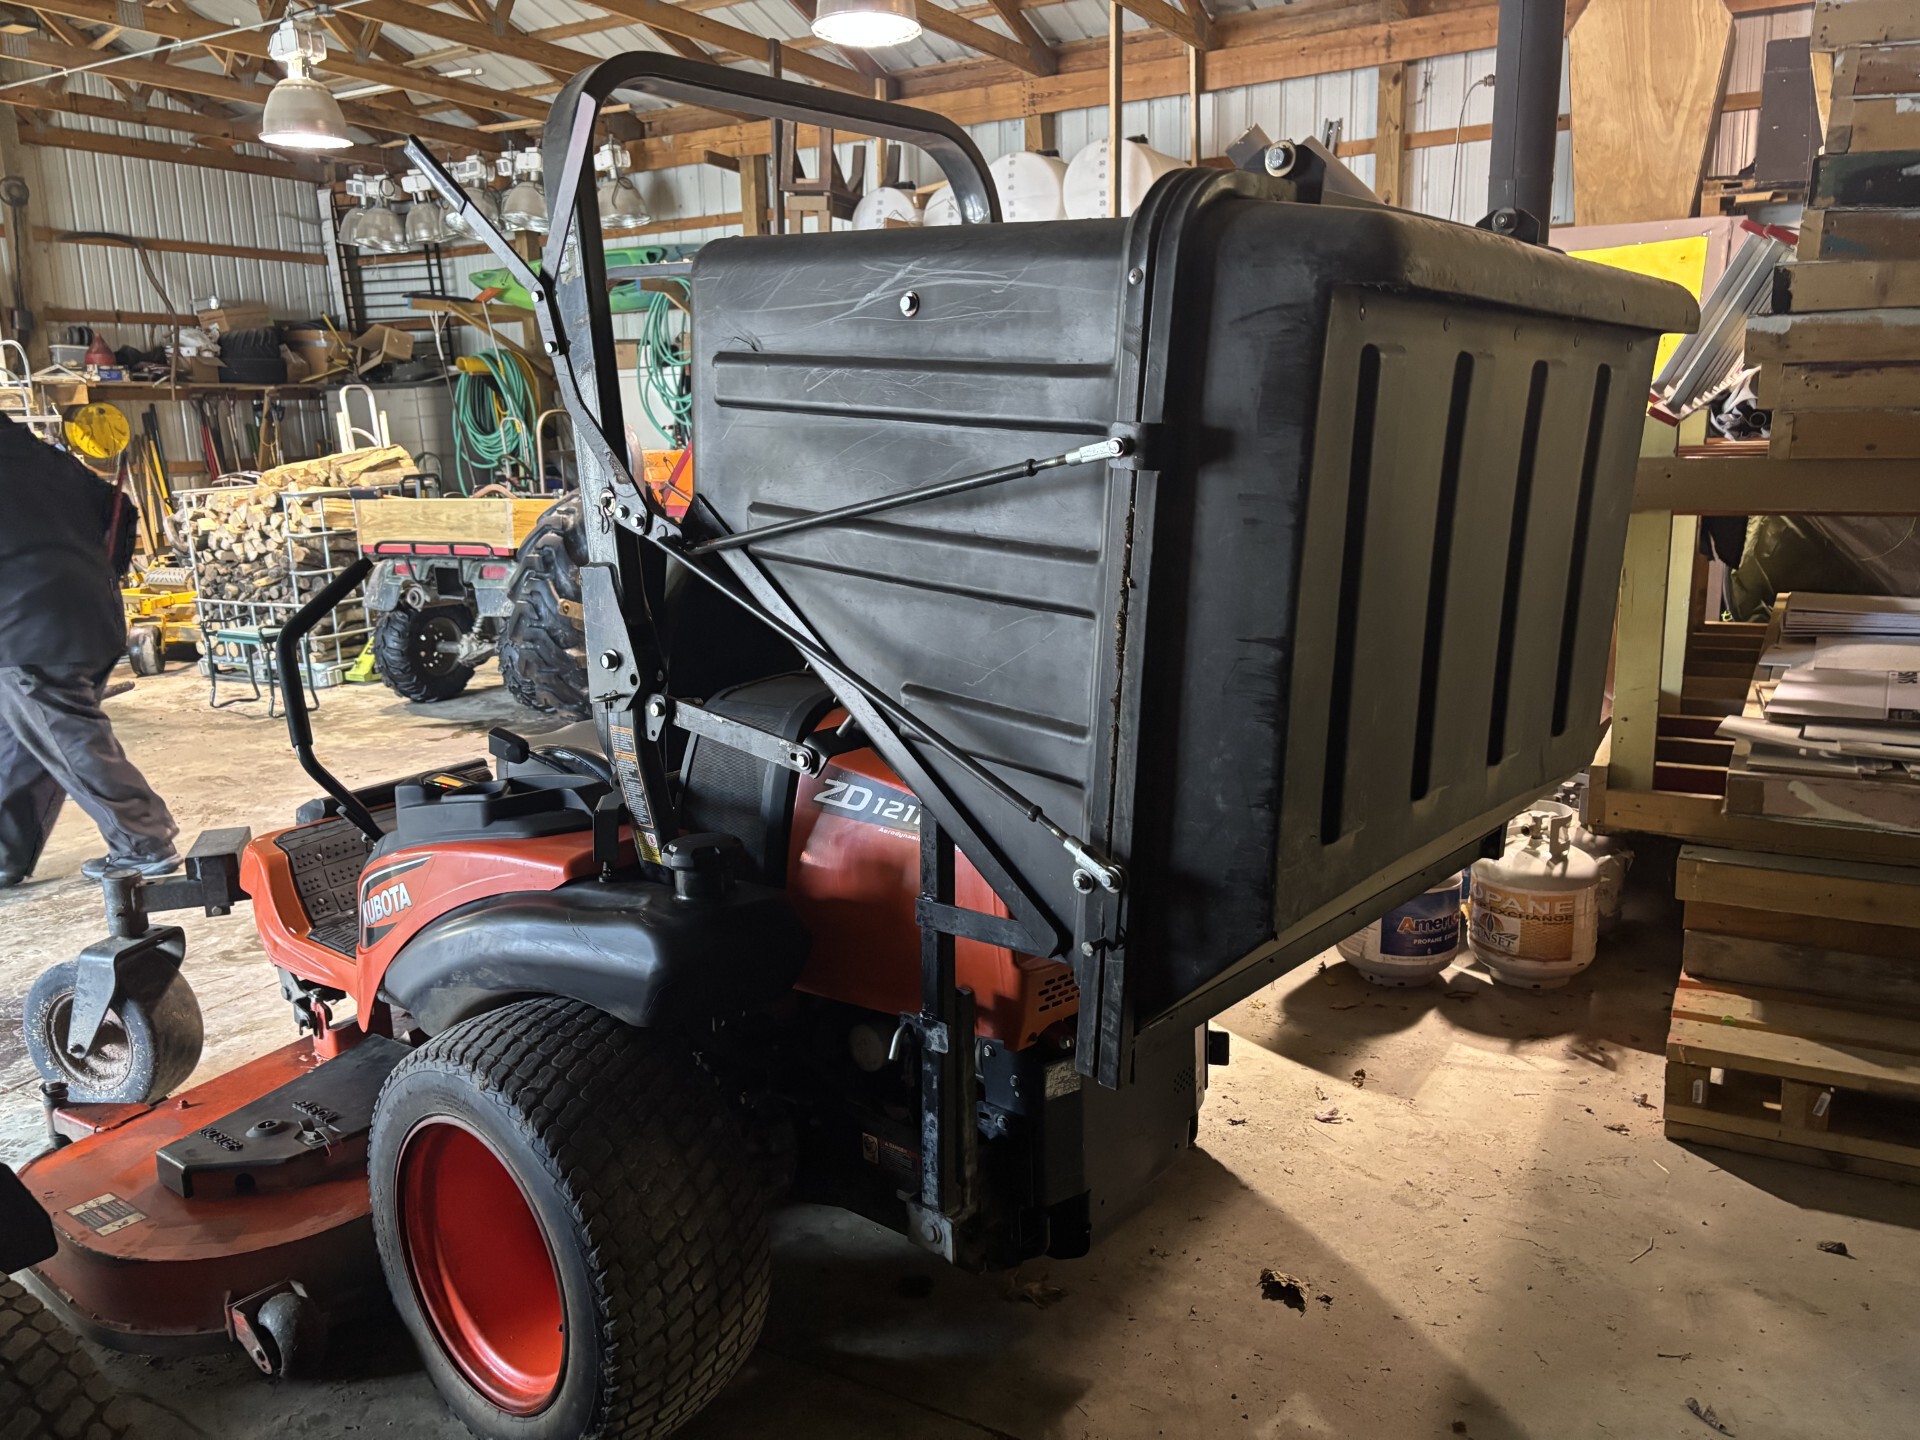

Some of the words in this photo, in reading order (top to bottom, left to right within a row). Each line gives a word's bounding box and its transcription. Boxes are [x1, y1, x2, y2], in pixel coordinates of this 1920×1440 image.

[813, 778, 873, 811] ZD
[363, 882, 412, 926] KUBOTA
[1413, 936, 1442, 945] PROPANE
